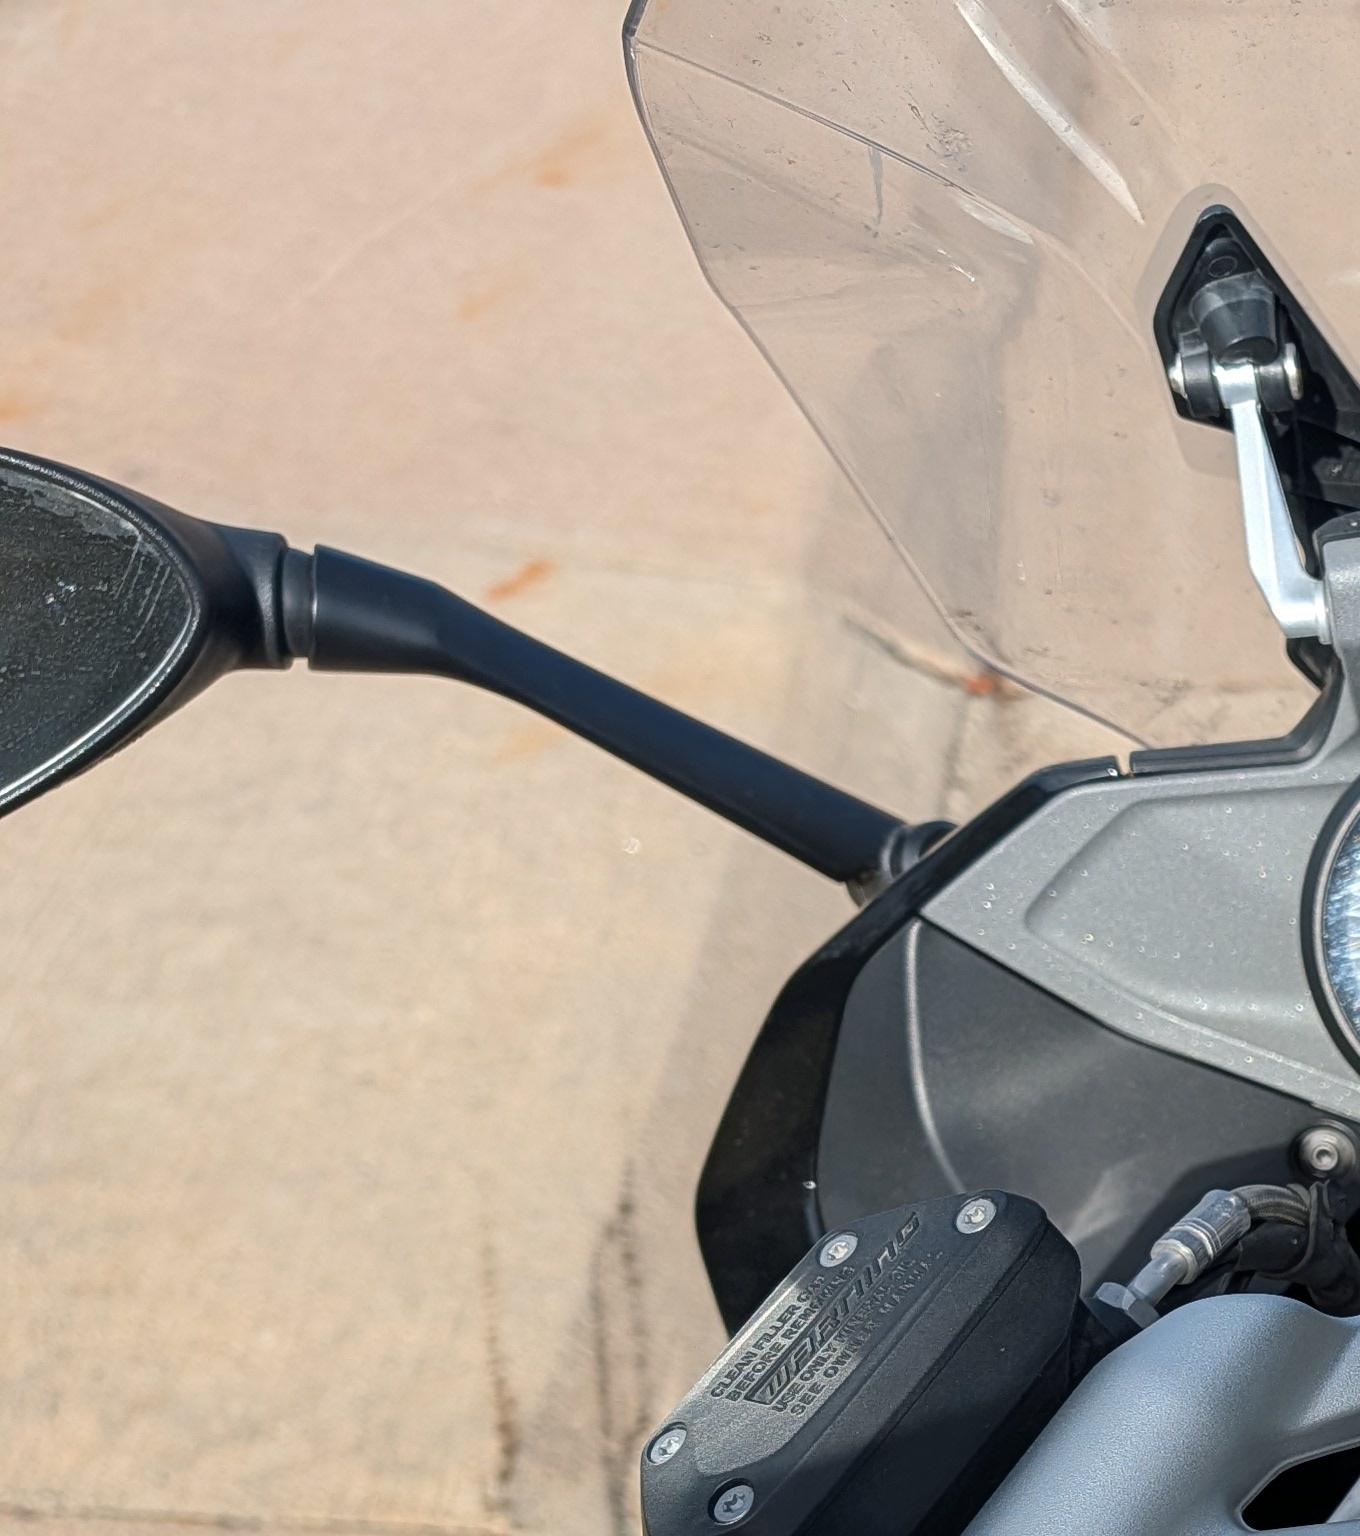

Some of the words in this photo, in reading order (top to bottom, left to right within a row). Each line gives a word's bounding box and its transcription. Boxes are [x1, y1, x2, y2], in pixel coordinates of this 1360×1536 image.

[711, 1351, 758, 1398] CLEAN
[758, 1305, 800, 1353] FILLER
[726, 1341, 787, 1402] BEFORE
[771, 1379, 806, 1414] USE
[800, 1342, 838, 1382] ONLY
[790, 1381, 826, 1416] SEE
